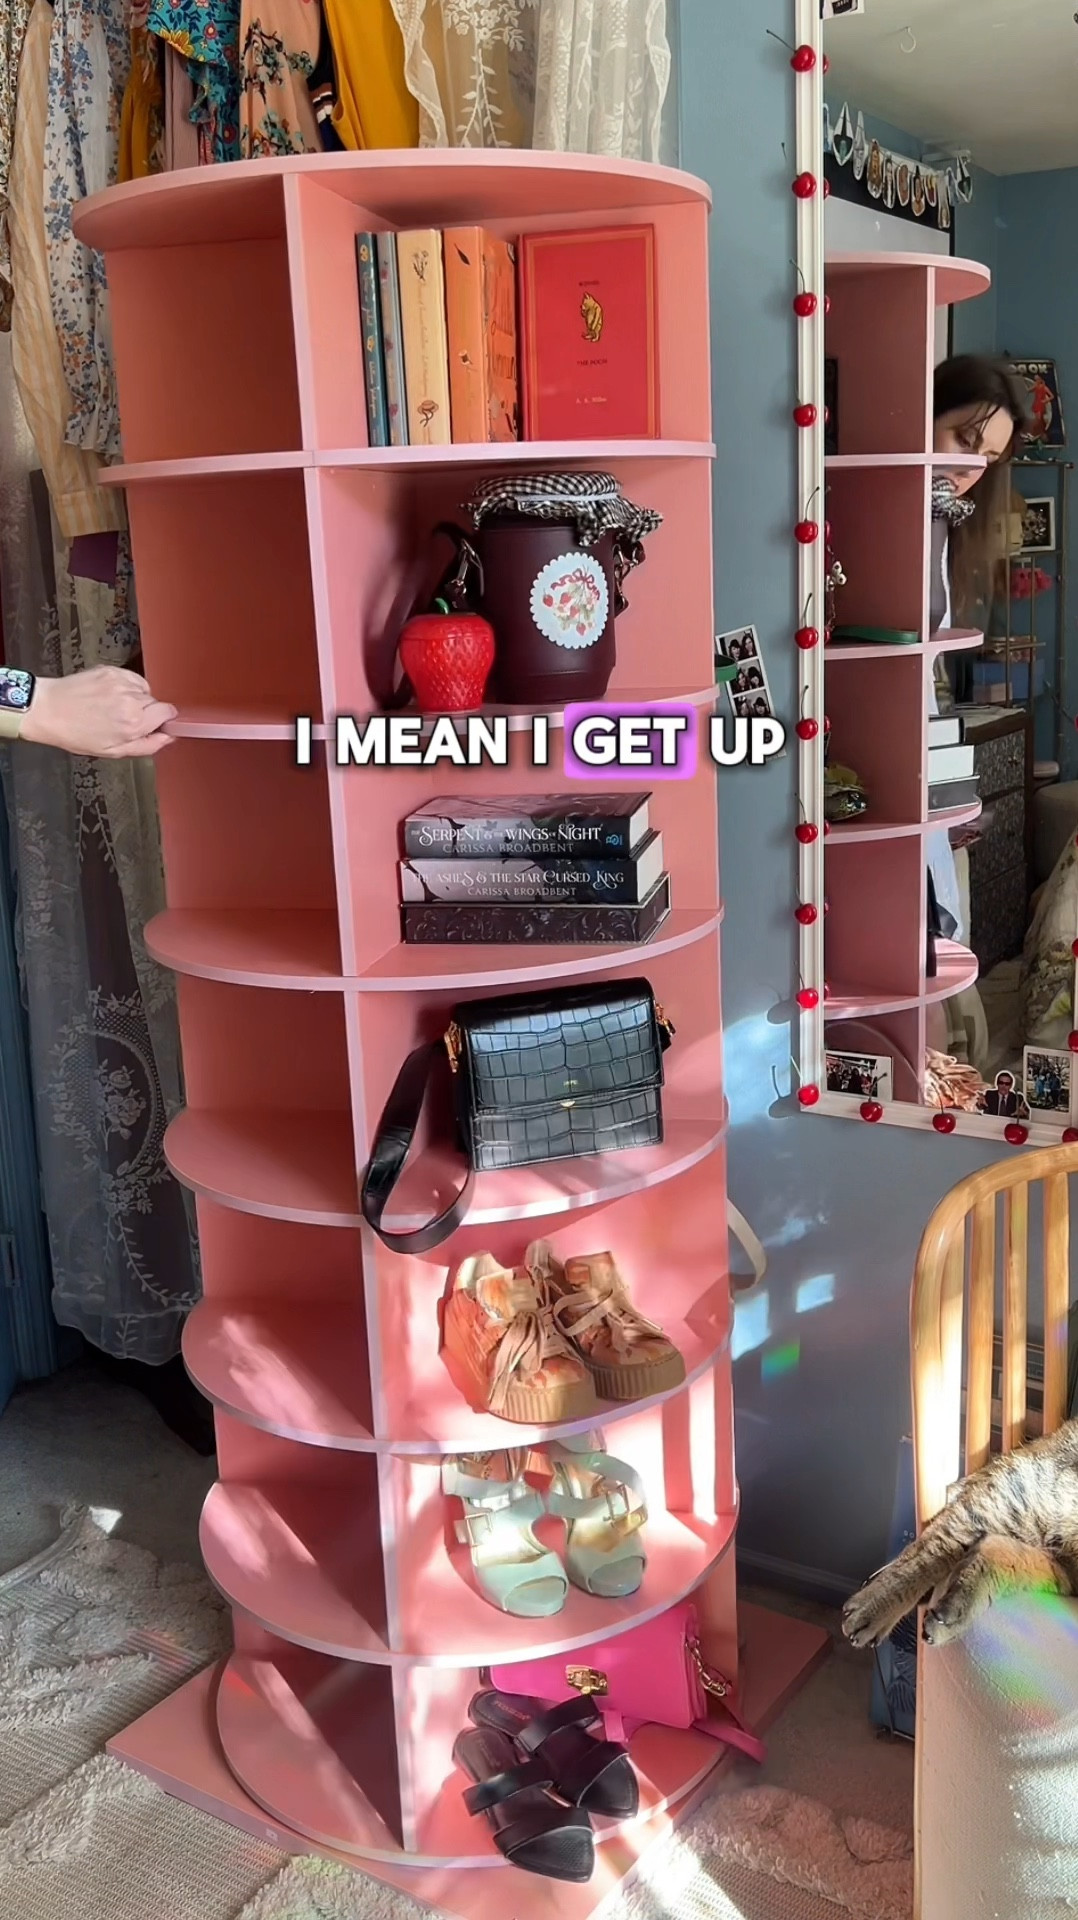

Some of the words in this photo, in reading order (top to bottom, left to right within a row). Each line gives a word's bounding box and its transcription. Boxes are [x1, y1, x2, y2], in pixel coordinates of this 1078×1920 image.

[505, 828, 549, 841] WINGS
[558, 823, 603, 841] NIGHT
[442, 843, 494, 853] CARISSA
[500, 843, 574, 854] BROADBENT
[490, 873, 512, 884] THE
[514, 873, 541, 884] STAR
[593, 870, 625, 891] KING
[467, 887, 511, 896] CARISSA
[514, 887, 576, 897] BROADBENT
